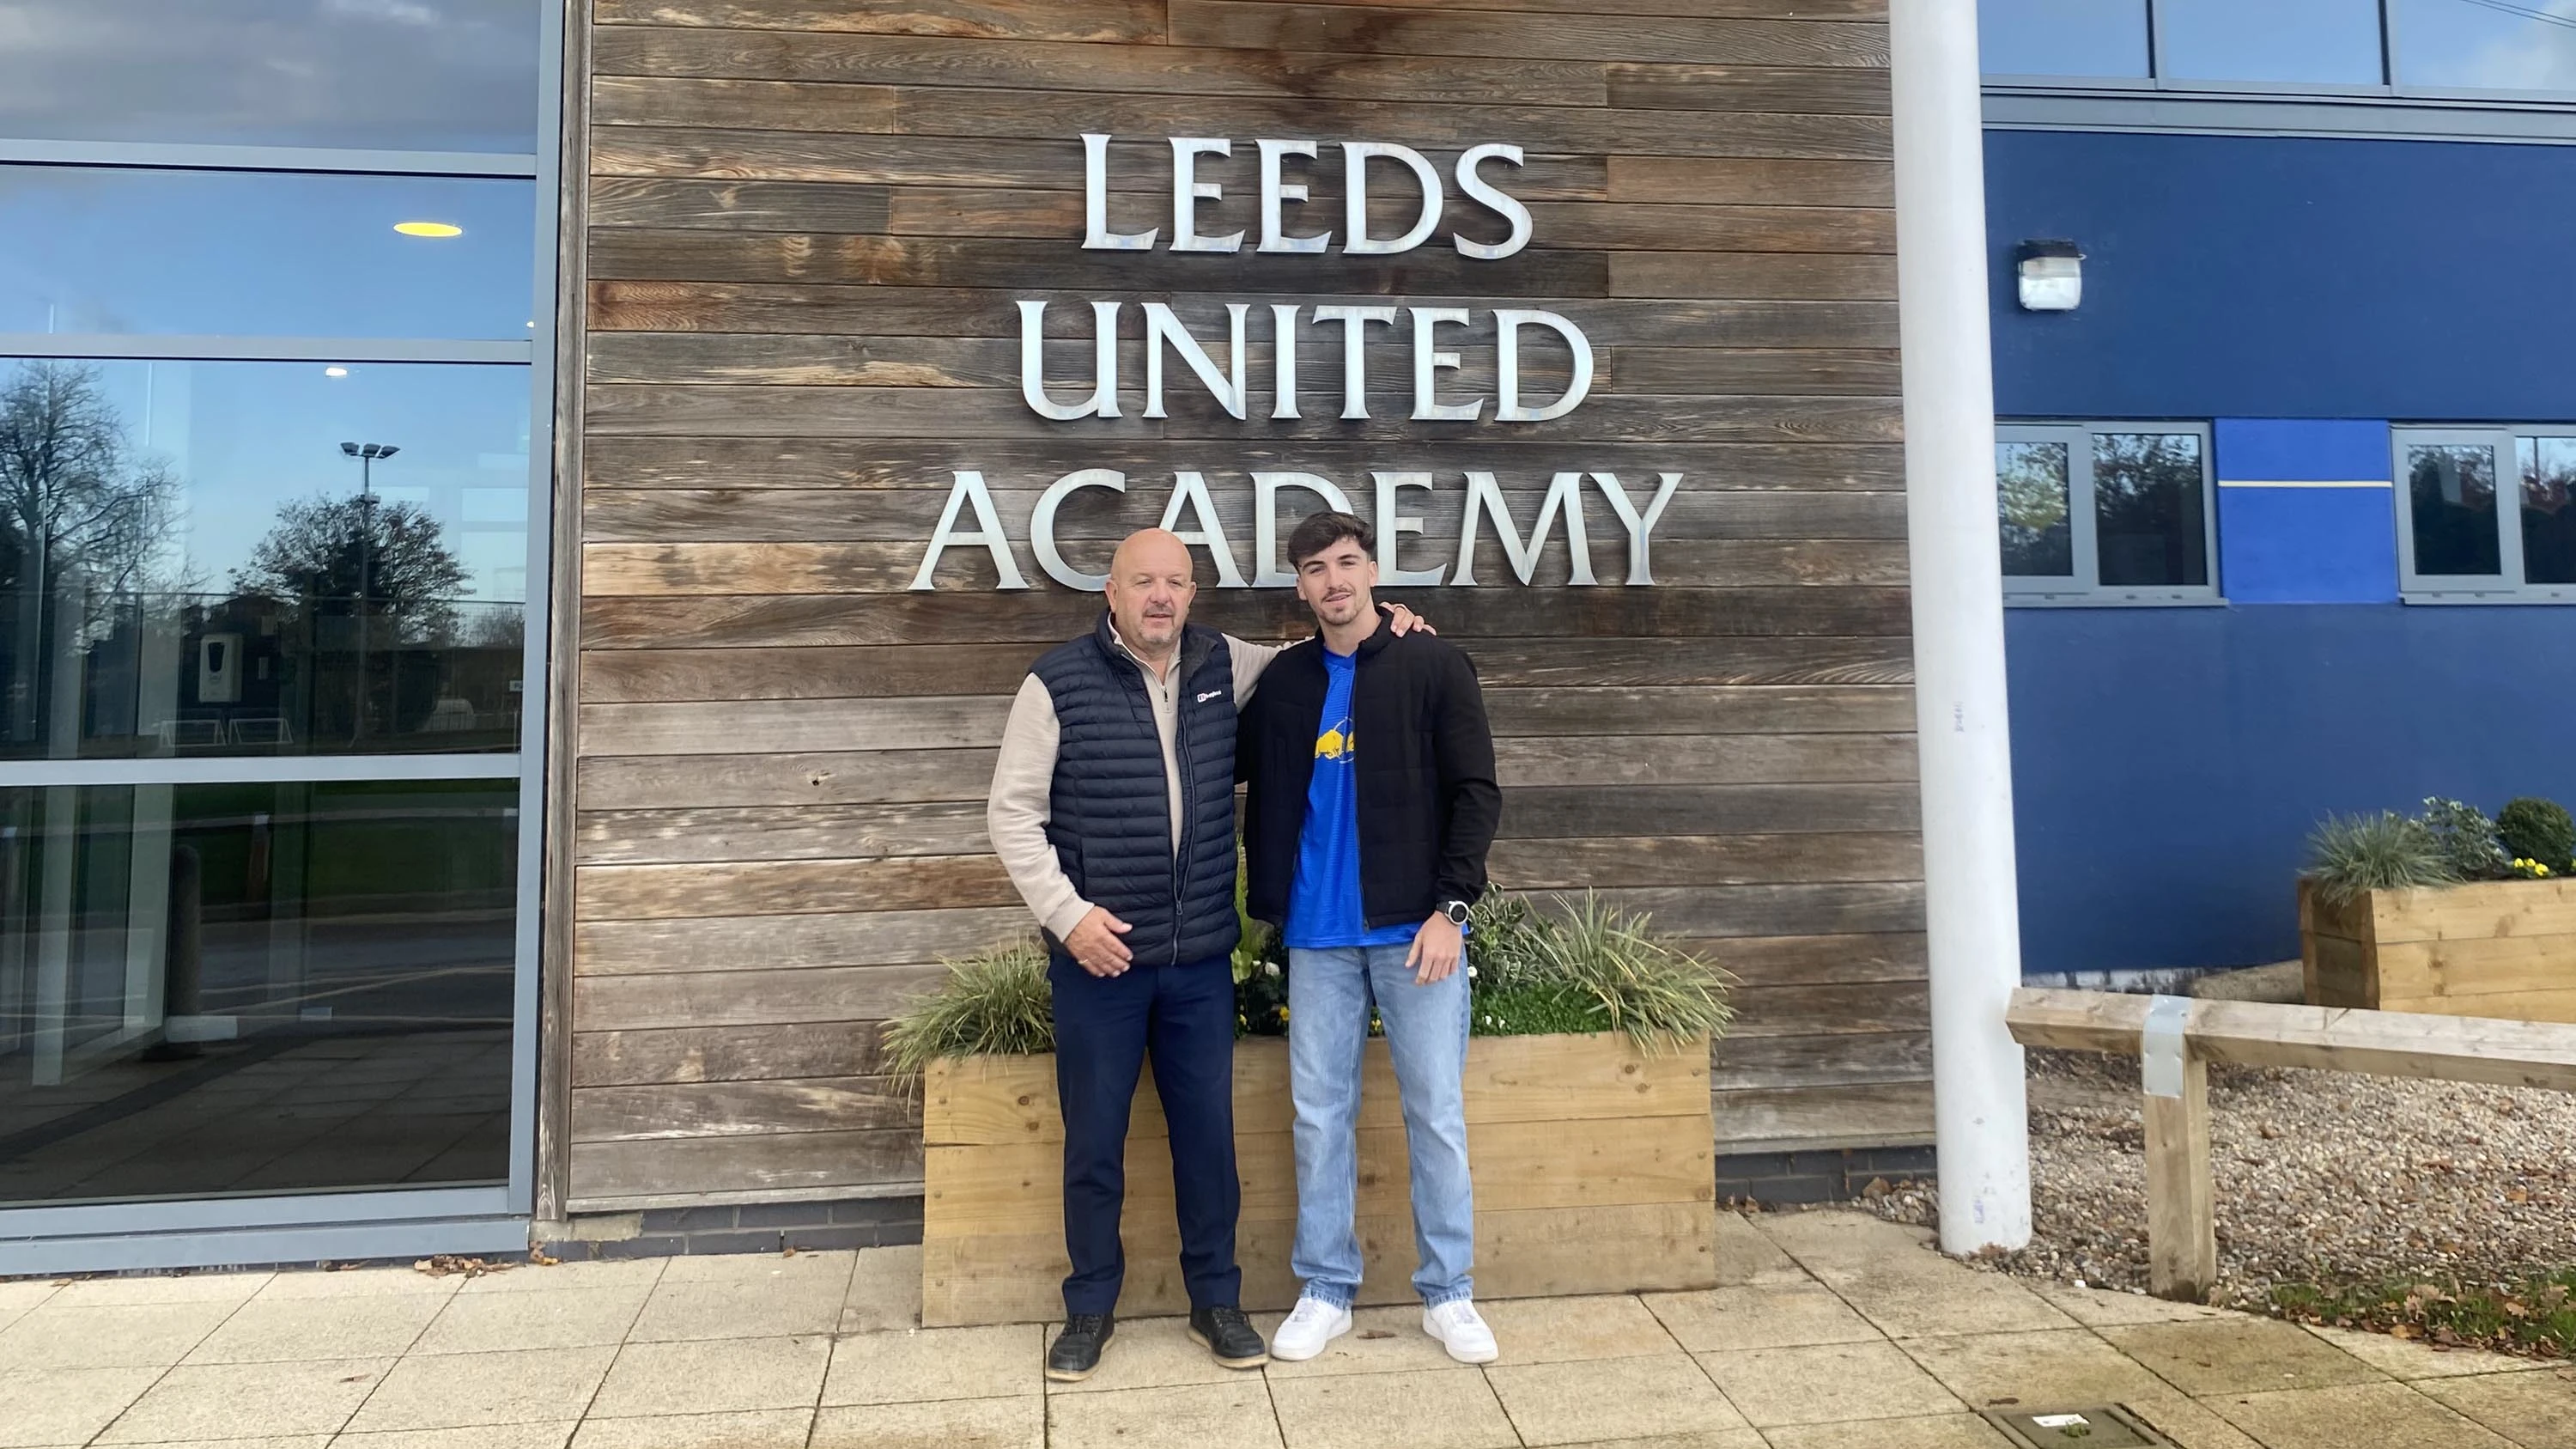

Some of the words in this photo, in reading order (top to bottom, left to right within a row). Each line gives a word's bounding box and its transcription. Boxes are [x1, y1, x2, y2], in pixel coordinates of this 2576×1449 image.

[1079, 133, 1534, 260] LEEDS
[1015, 300, 1595, 422] UNITED
[908, 468, 1685, 592] ACADEMY
